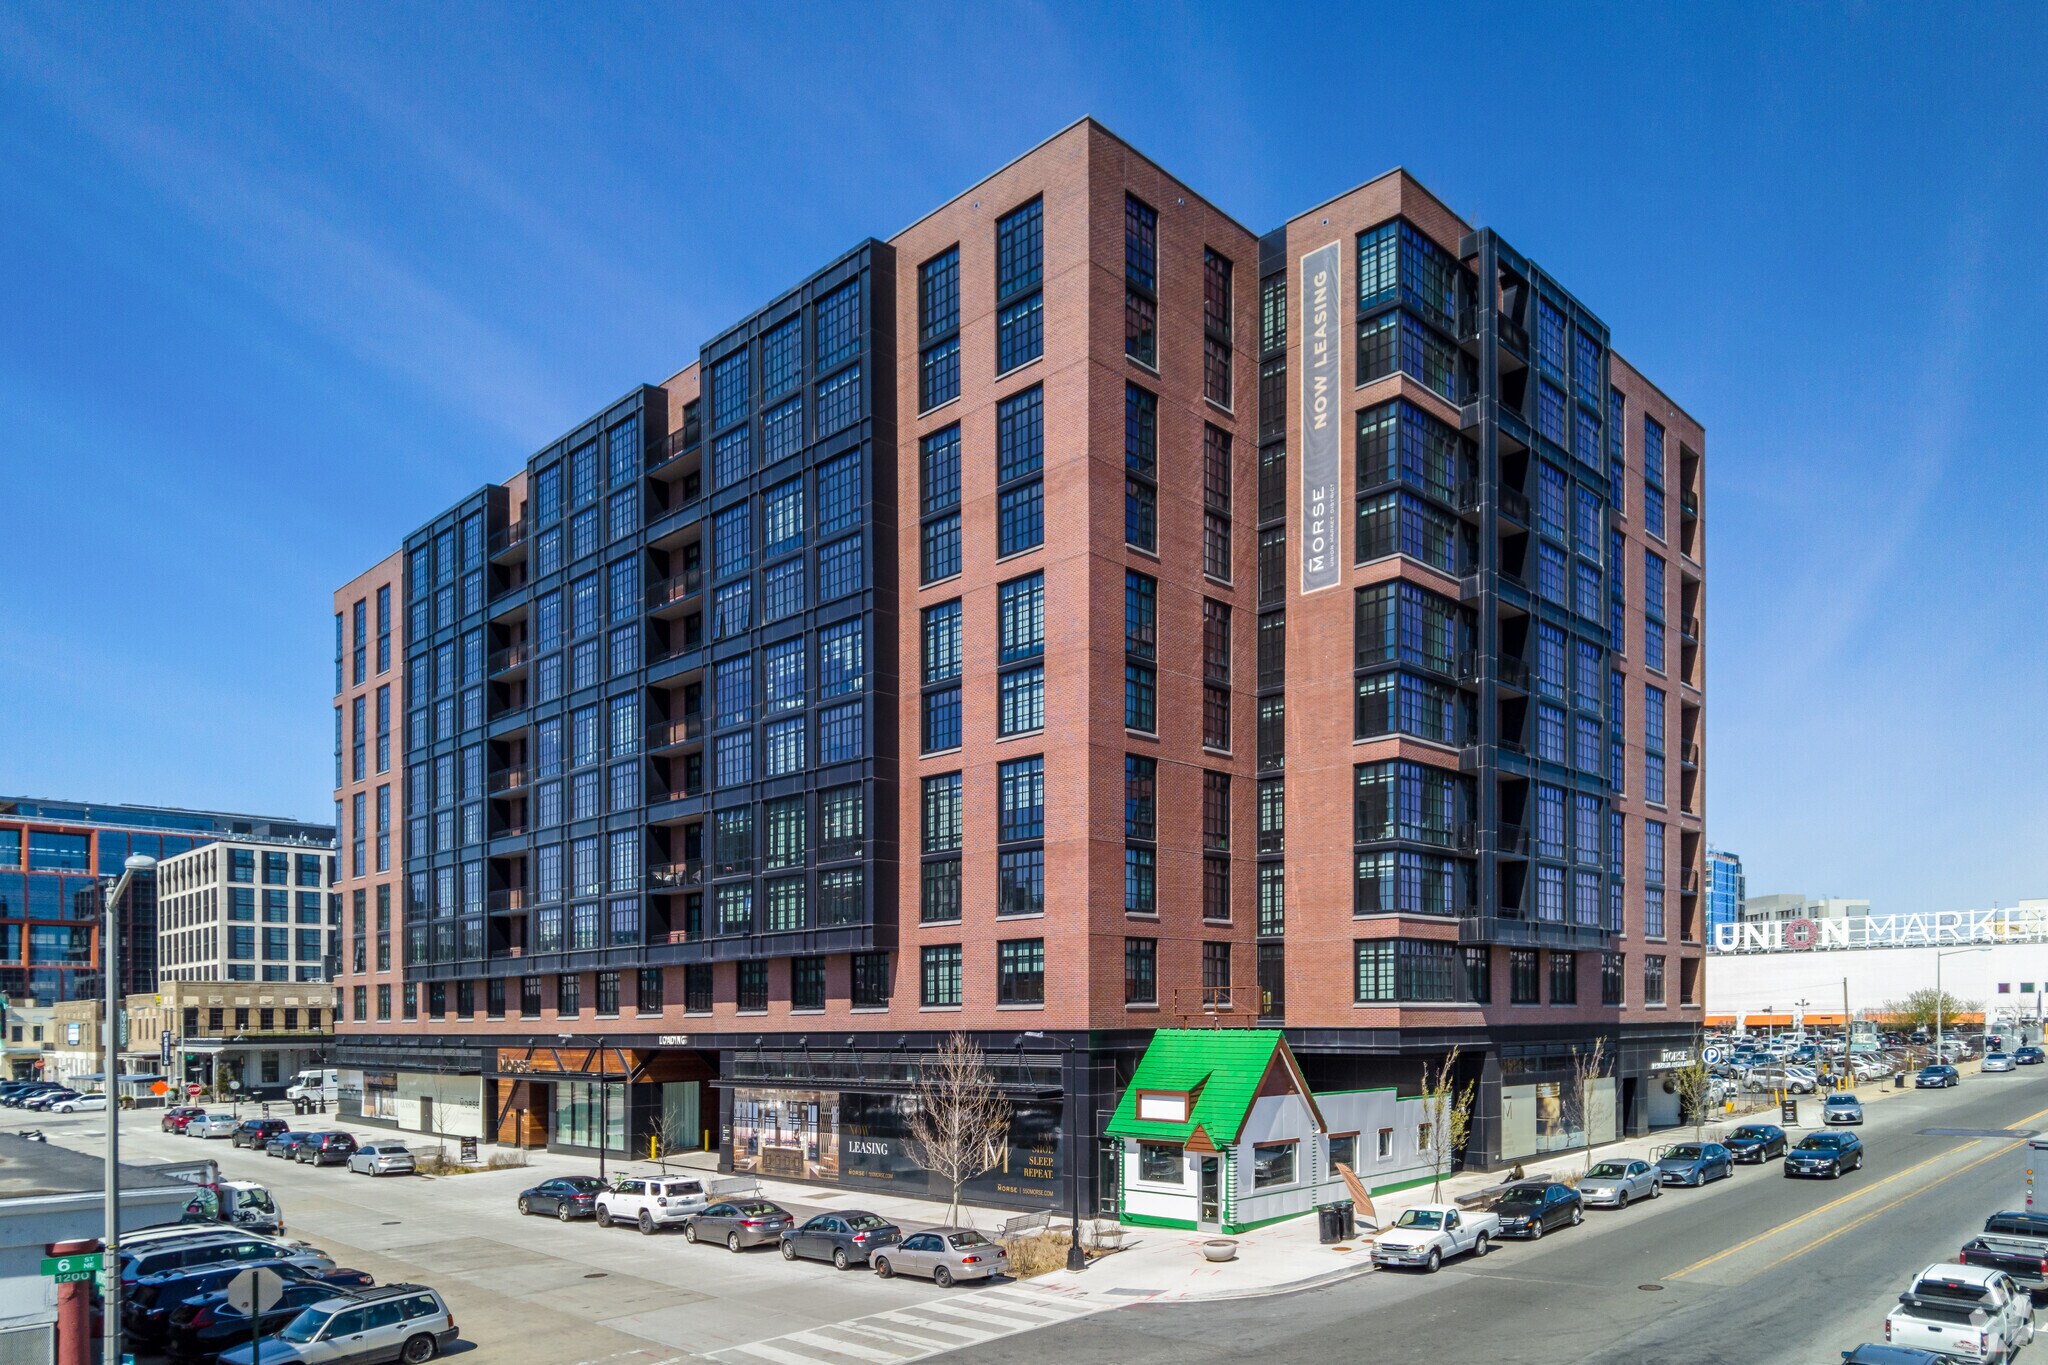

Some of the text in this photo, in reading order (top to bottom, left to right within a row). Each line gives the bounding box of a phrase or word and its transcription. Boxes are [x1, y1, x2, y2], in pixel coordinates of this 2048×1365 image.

[1314, 270, 1328, 430] NOW LEASING
[1309, 486, 1325, 573] MORSE
[1715, 916, 1850, 951] UNION
[658, 1035, 688, 1045] LOADING
[1707, 1049, 1718, 1063] P
[848, 1140, 888, 1156] LEASING
[1023, 1167, 1054, 1180] REPEAT.
[997, 1183, 1018, 1194] MORSE
[57, 1258, 71, 1272] 6
[83, 1261, 95, 1269] NE
[56, 1272, 90, 1283] 1200
